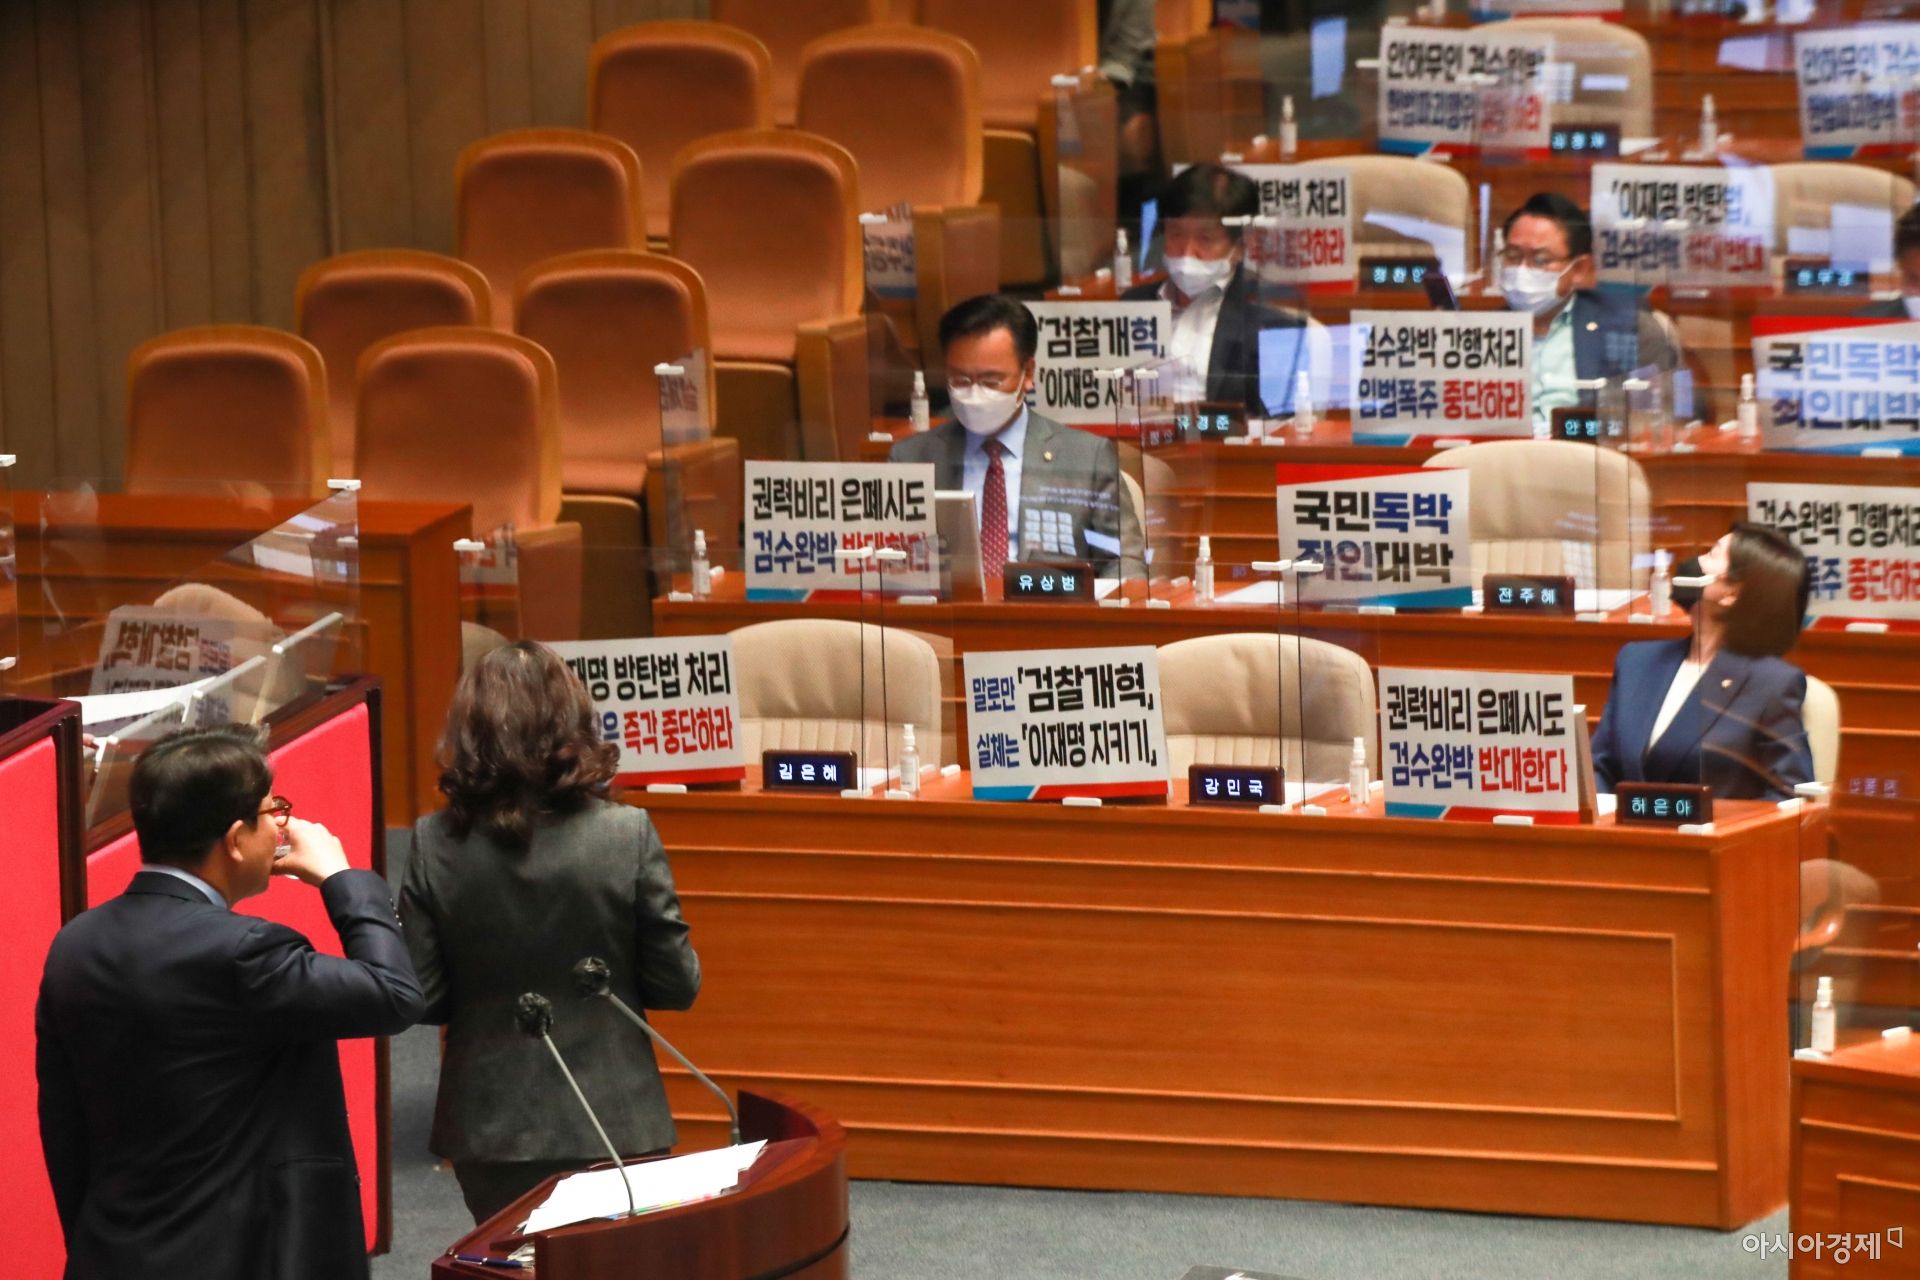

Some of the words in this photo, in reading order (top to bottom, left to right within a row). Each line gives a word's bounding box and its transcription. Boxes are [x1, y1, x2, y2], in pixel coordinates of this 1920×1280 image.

[1257, 178, 1301, 218] 탄법
[1306, 176, 1346, 218] 처리
[1360, 325, 1437, 369] 검수완박
[1442, 326, 1524, 370] 강행처리
[1768, 342, 1920, 384] 국민독박
[1443, 378, 1524, 421] 중단하라
[752, 476, 836, 521] 권력비리
[1293, 490, 1453, 535] 국민독박
[1757, 499, 1841, 546] 검수완박
[753, 530, 837, 575] 검수완박
[1019, 574, 1076, 592] 유상범
[1499, 585, 1556, 605] 전주혜
[614, 653, 682, 703] 방탄법
[685, 650, 732, 697] 처리
[972, 675, 1017, 714] 말로만
[623, 708, 659, 756] 즉각
[661, 706, 735, 756] 중단하라
[1387, 684, 1473, 734] 권력비리
[1477, 687, 1566, 738] 은폐시도
[976, 731, 1020, 770] 실체는
[1389, 741, 1475, 791] 검수완박
[1479, 746, 1569, 794] 반대한다
[778, 762, 838, 783] 김은혜
[1204, 777, 1264, 798] 강민국
[1631, 796, 1692, 817] 허은아
